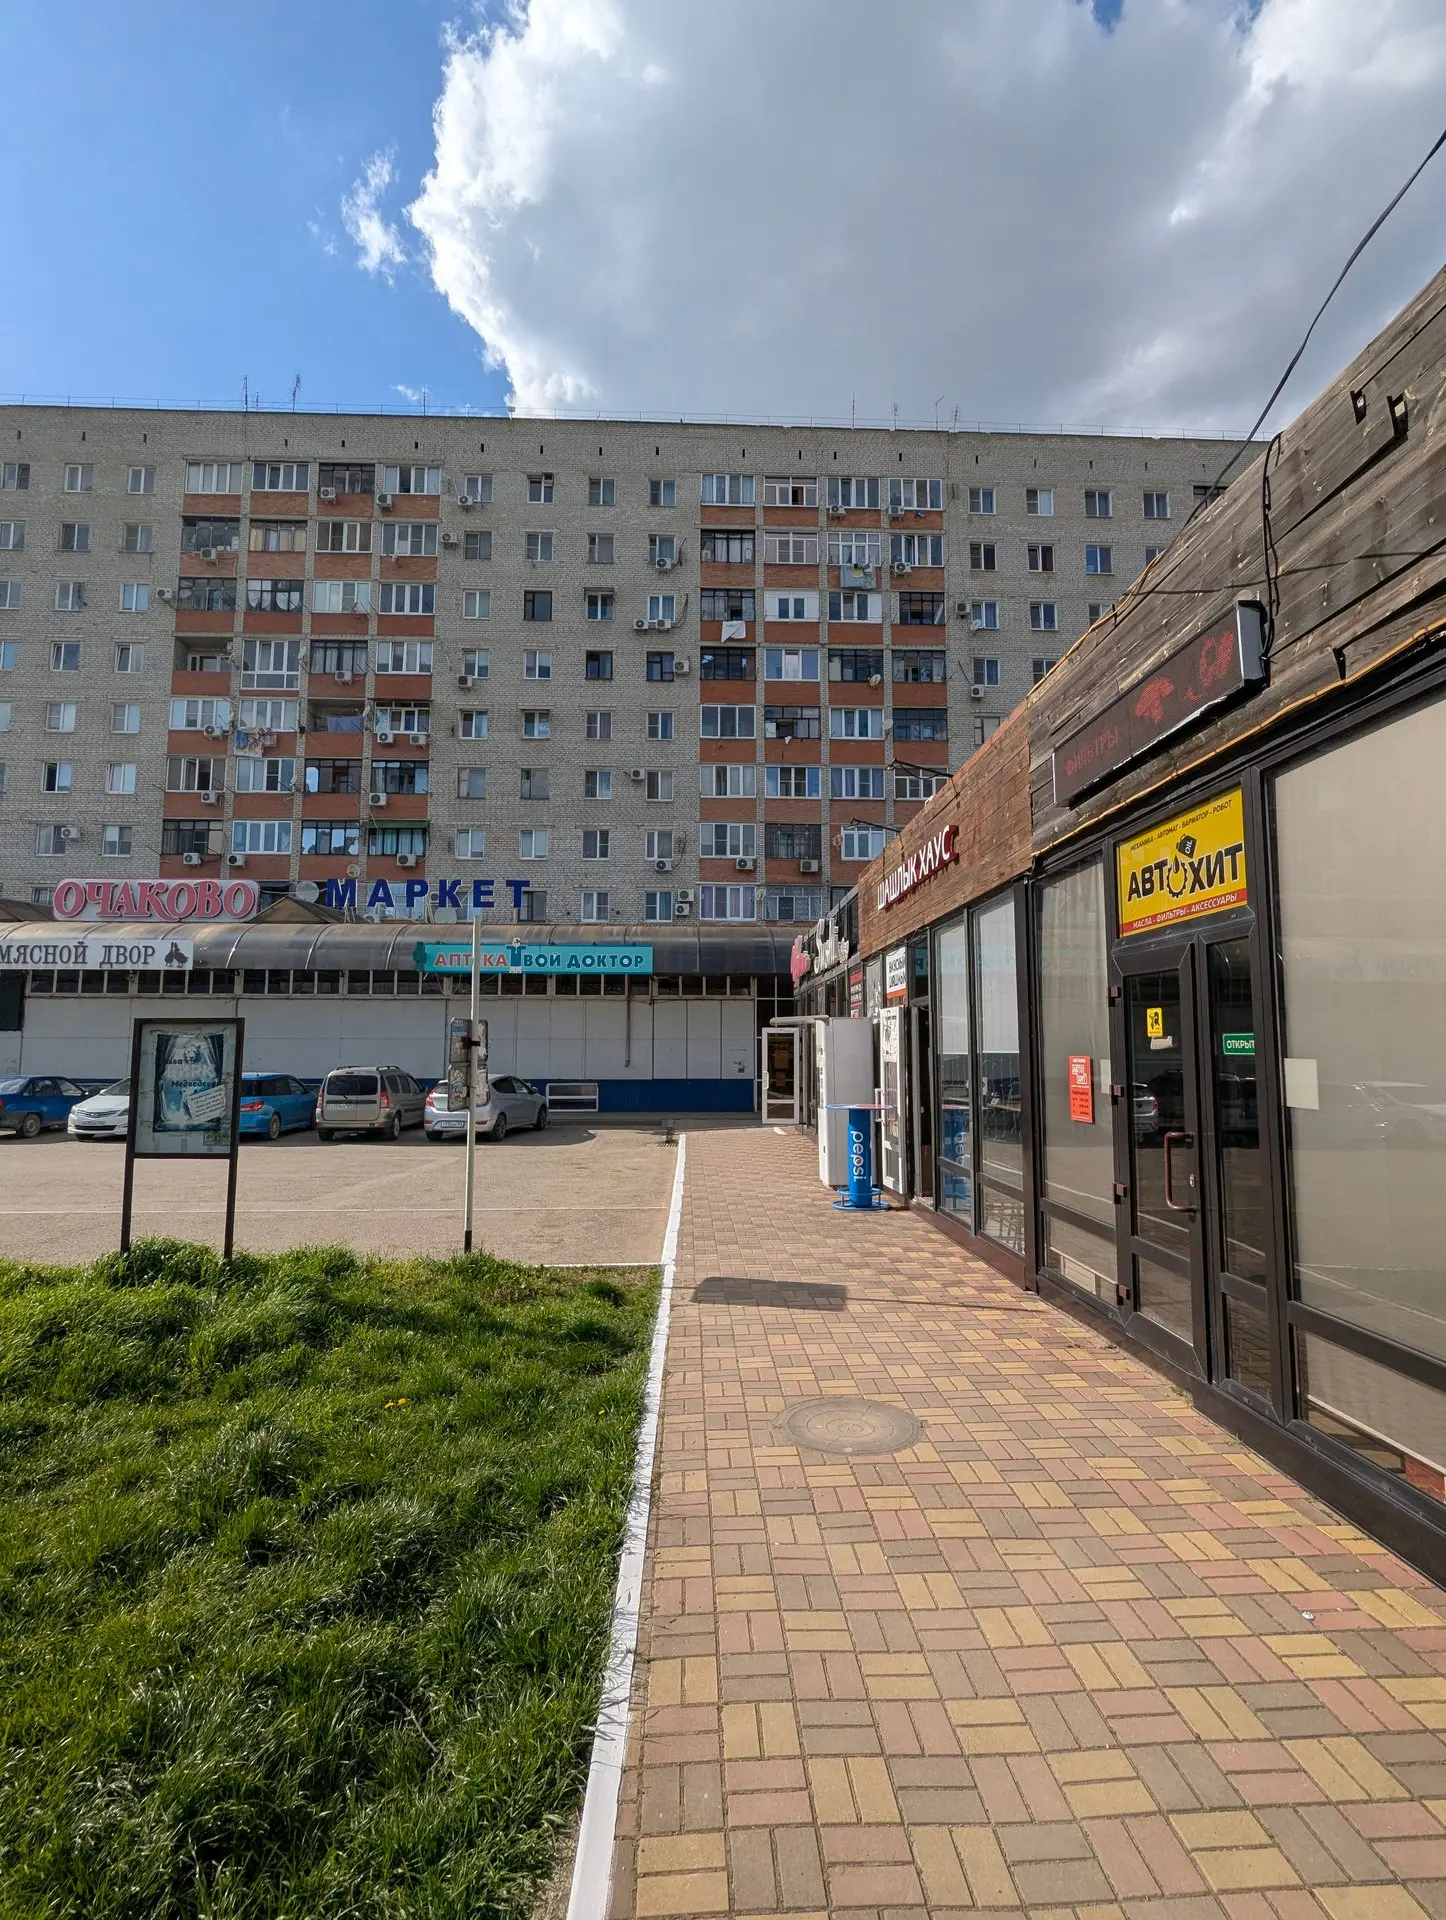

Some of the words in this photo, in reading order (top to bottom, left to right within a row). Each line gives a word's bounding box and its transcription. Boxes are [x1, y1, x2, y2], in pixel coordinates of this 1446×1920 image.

[1130, 837, 1154, 850] МЕХАНИКА
[1157, 825, 1178, 840] АВТОМАТ
[1182, 810, 1209, 828] ВАРИАТОР
[1213, 800, 1232, 815] РОБОТ
[1185, 840, 1193, 854] OIL
[878, 853, 917, 910] ШАШЛЫК
[919, 825, 952, 880] ХАУС
[53, 881, 255, 922] ОЧАКОВО
[326, 879, 531, 908] МАРКЕТ
[1133, 917, 1152, 929] МАСЛА
[1156, 909, 1186, 923] ФИЛЬТРЫ
[1191, 893, 1237, 913] АКСЕССУАРЫ
[0, 940, 88, 964] МЯСНОЙ
[100, 945, 155, 968] ДВОР
[434, 953, 509, 968] АПТКА
[567, 954, 644, 968] ДОКТОР
[850, 1131, 867, 1182] pepsi
